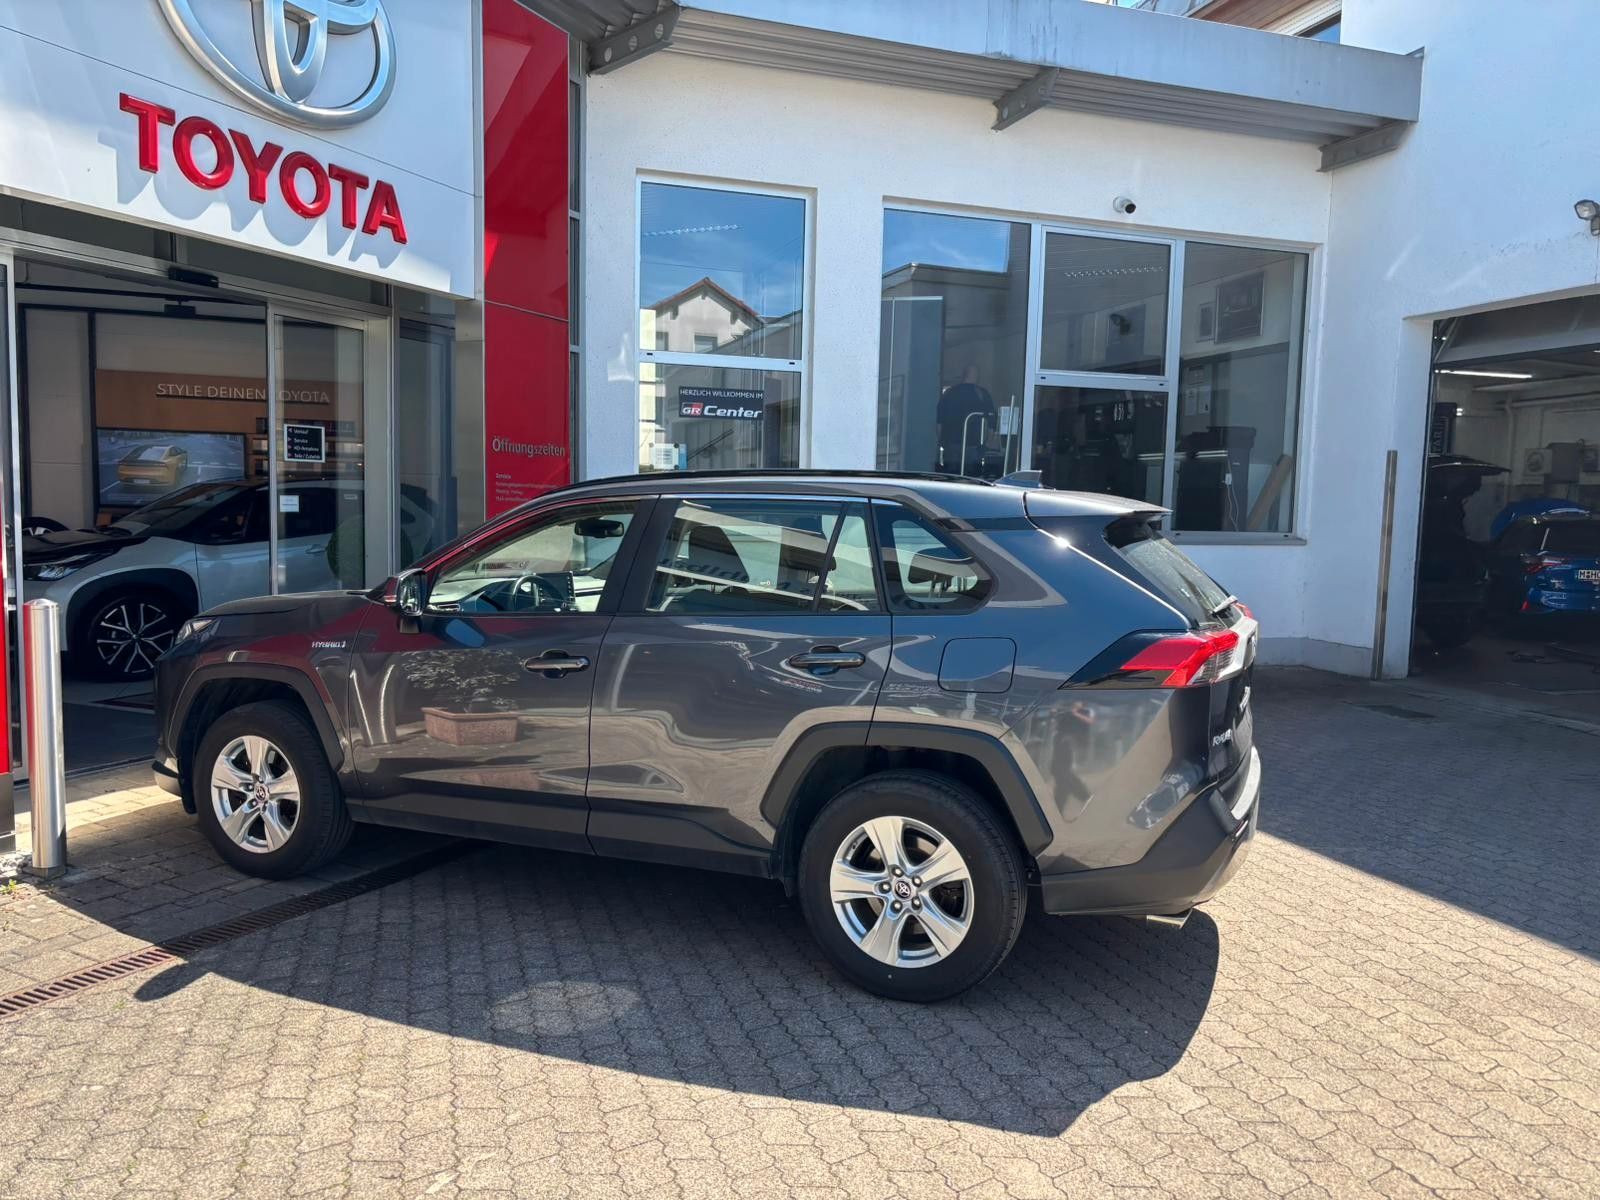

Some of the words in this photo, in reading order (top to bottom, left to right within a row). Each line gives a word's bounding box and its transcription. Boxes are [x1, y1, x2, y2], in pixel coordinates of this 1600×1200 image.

[119, 92, 407, 244] TOYOTA
[156, 383, 202, 397] STYLE
[207, 385, 266, 400] DEINEN
[278, 389, 330, 402] OYOTA
[679, 388, 711, 397] HERZLICH
[713, 390, 755, 399] WILLKOMMEN
[682, 406, 702, 416] GR
[703, 405, 762, 418] Center
[492, 436, 566, 458] Öffnungszeiten
